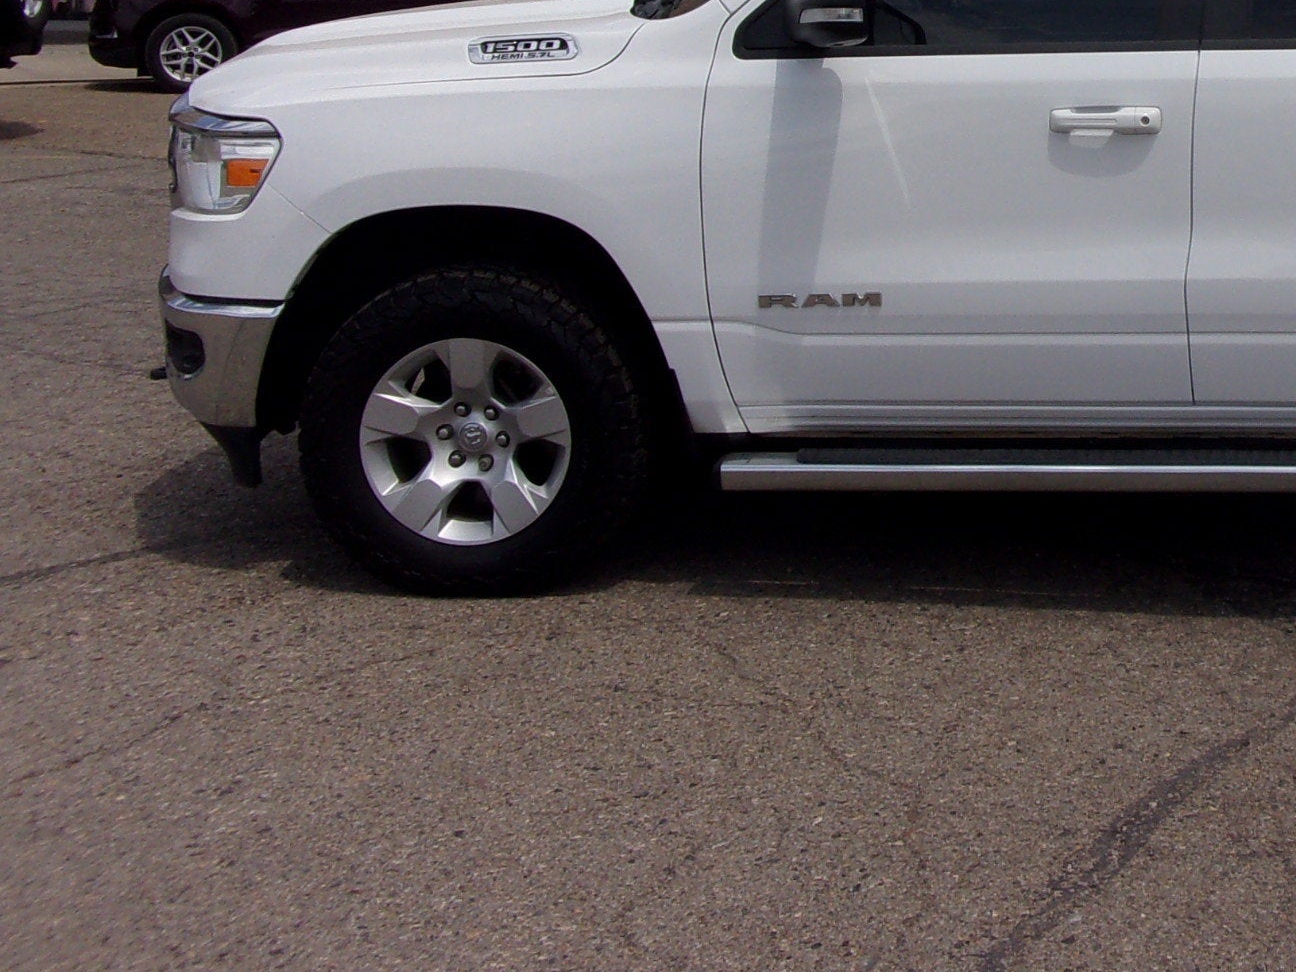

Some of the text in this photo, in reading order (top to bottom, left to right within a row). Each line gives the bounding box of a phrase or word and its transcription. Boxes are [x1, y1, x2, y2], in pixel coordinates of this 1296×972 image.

[485, 39, 561, 53] 1500
[491, 51, 555, 61] HEMI 5.7L
[758, 292, 882, 309] RAM
